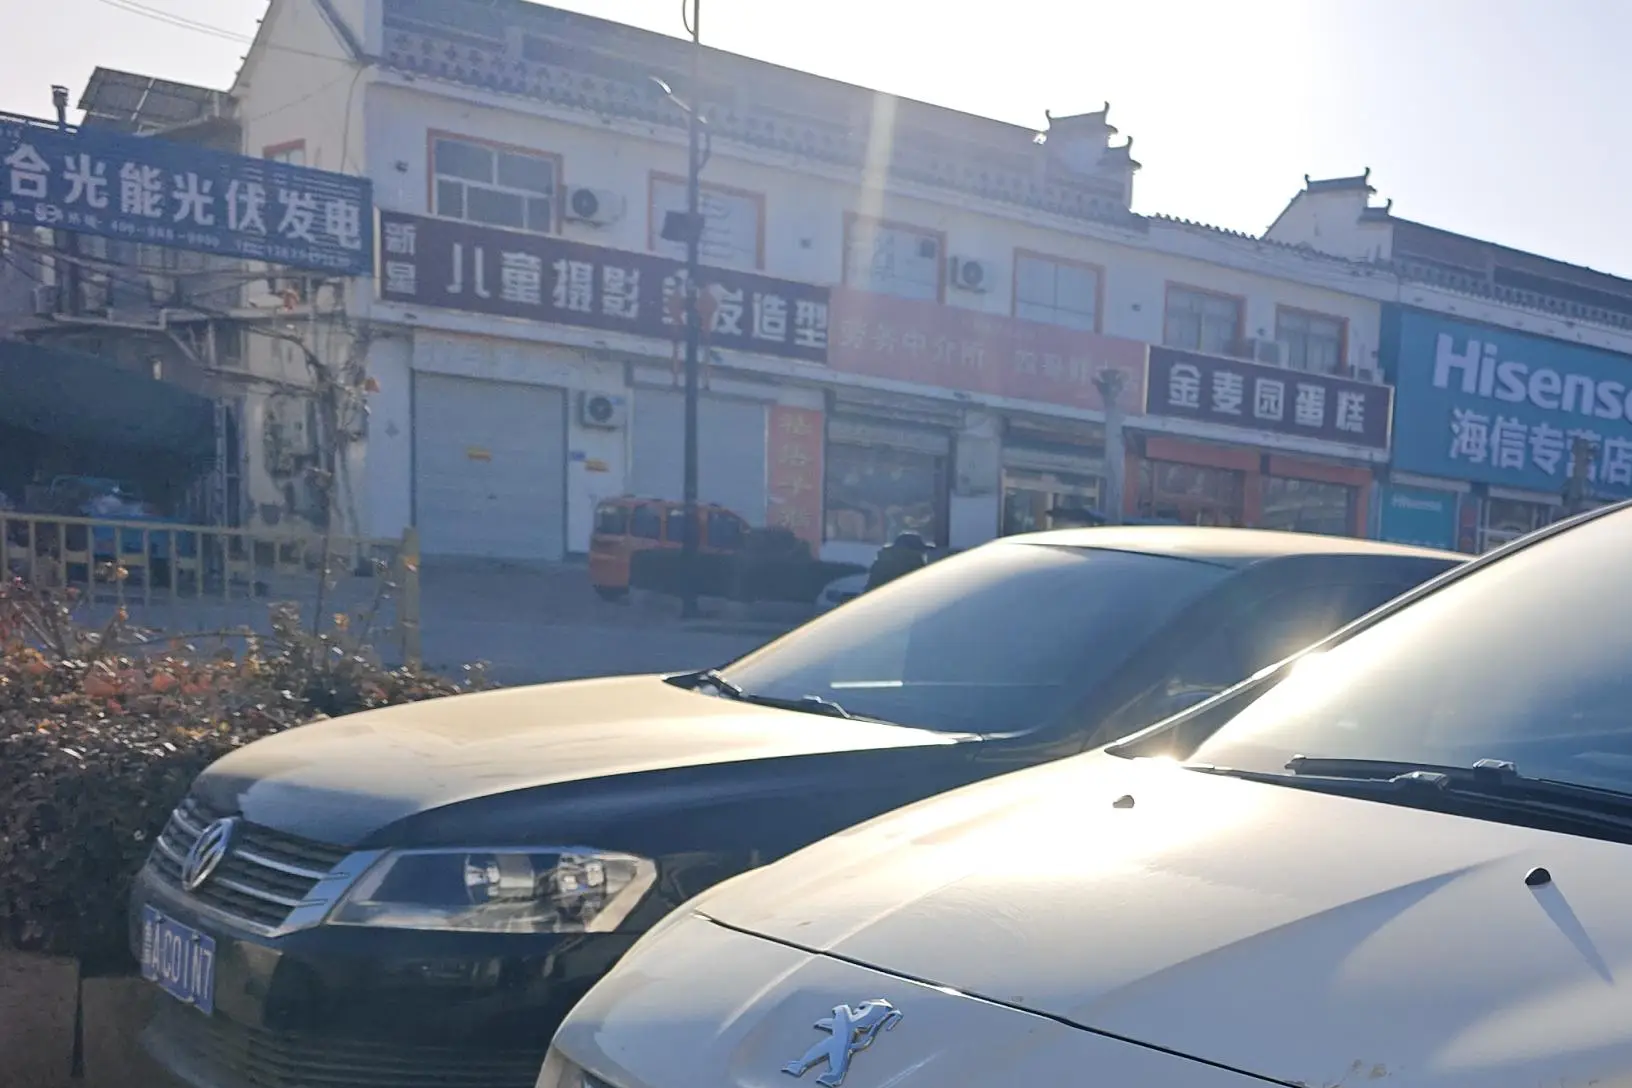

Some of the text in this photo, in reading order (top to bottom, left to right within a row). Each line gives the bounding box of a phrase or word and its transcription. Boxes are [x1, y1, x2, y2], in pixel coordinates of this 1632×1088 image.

[5, 144, 361, 249] 合光能光伏发电
[446, 242, 640, 319] 儿童摄影
[1168, 364, 1366, 432] 金麦园蛋糕
